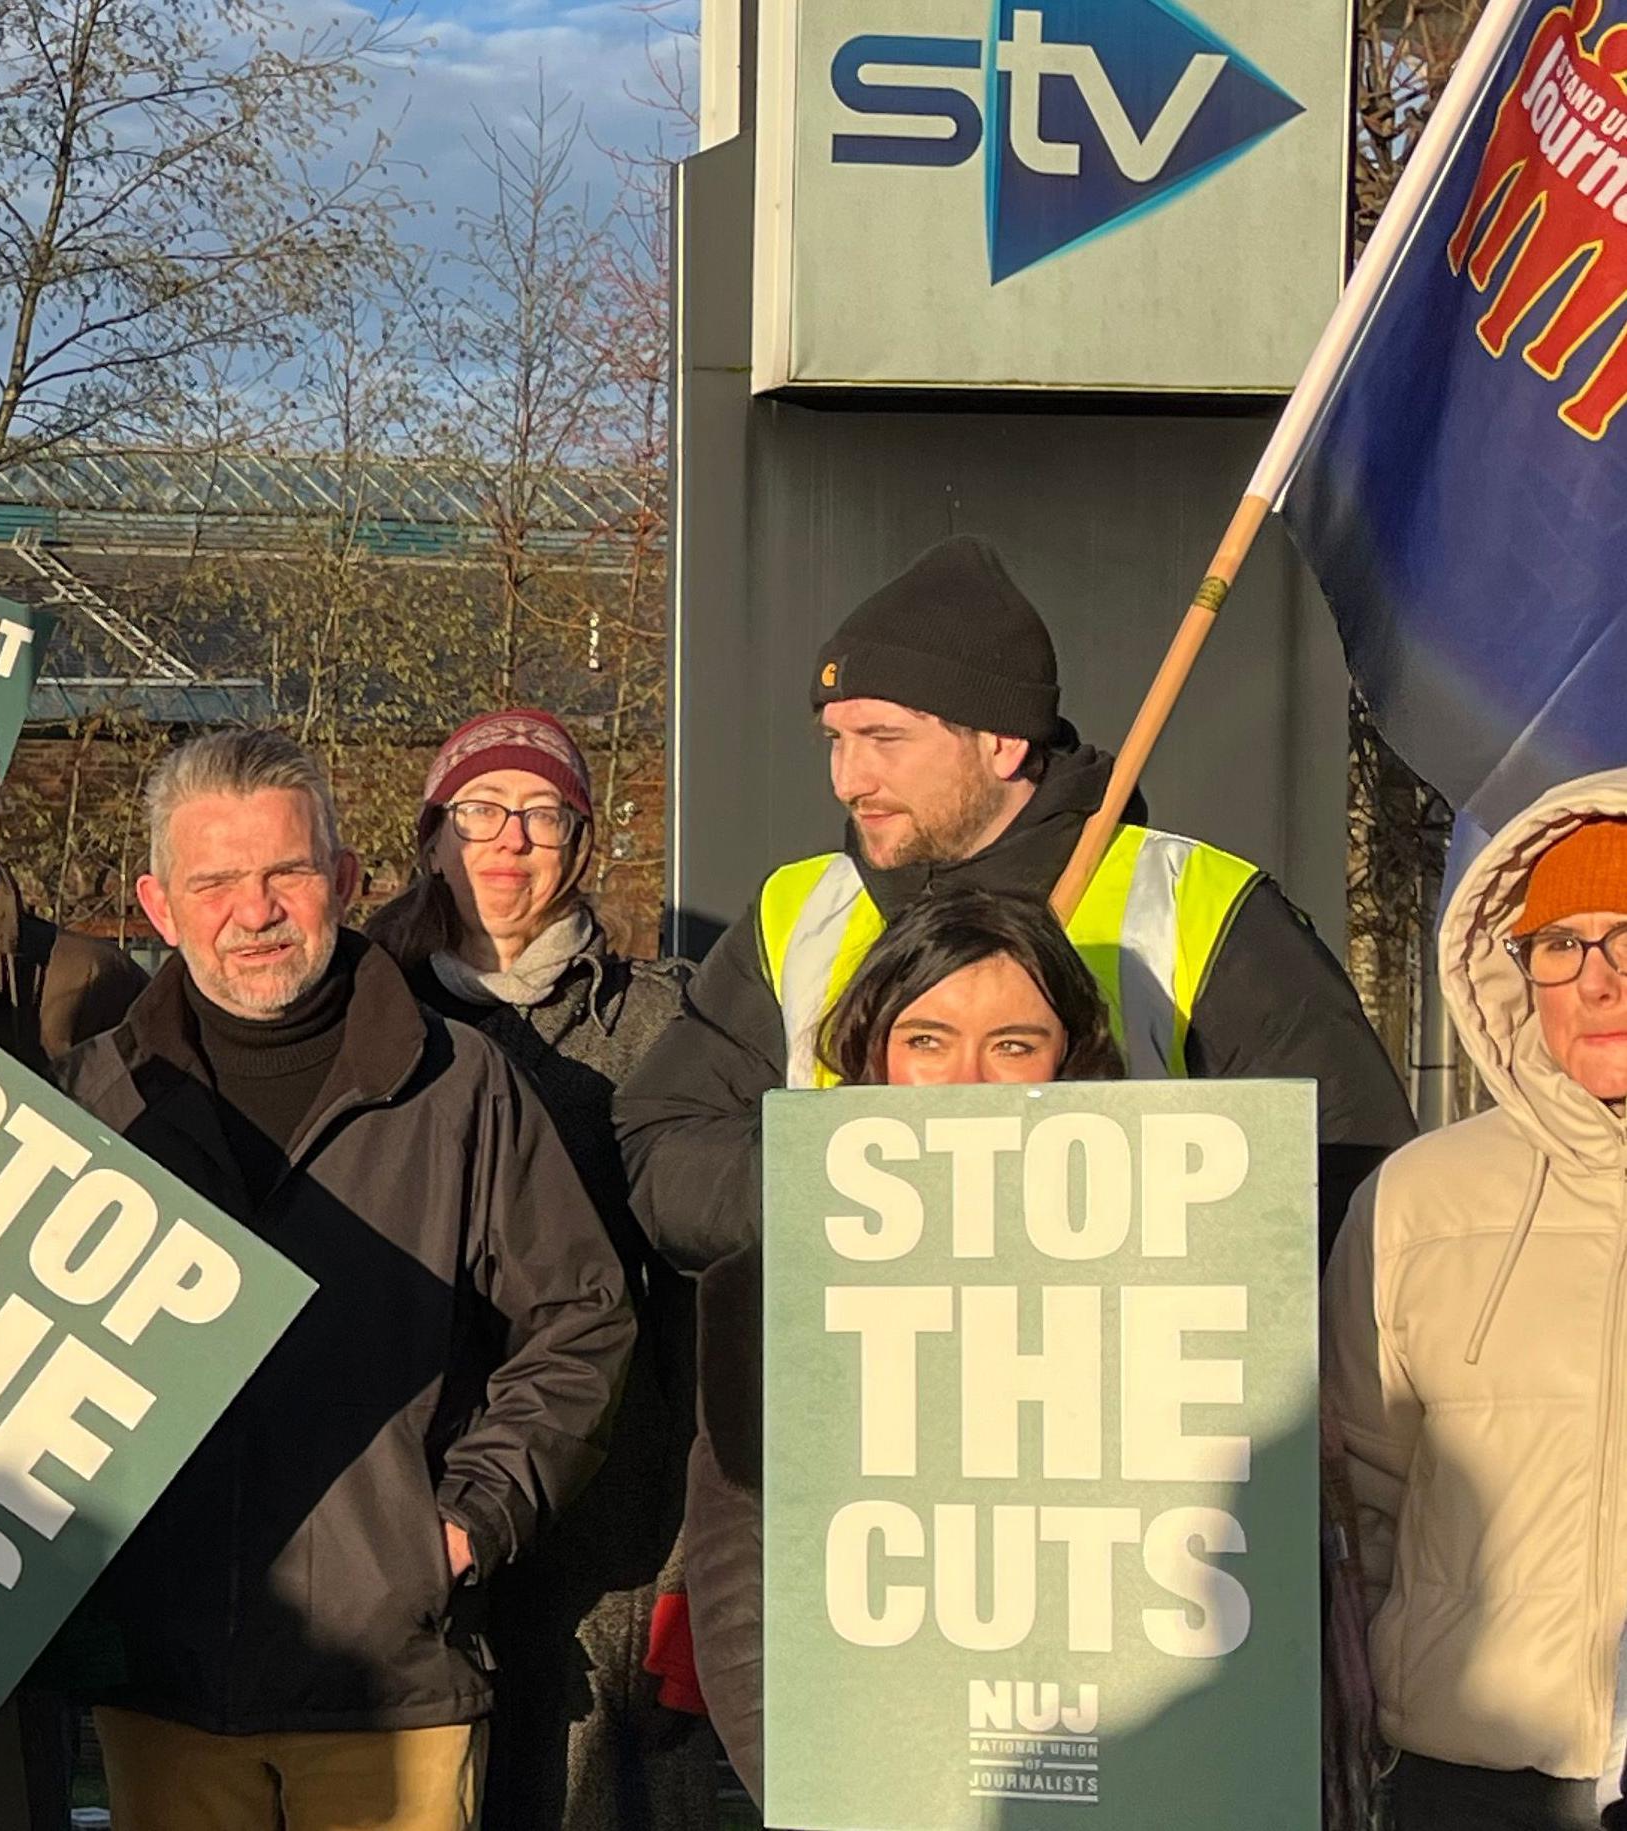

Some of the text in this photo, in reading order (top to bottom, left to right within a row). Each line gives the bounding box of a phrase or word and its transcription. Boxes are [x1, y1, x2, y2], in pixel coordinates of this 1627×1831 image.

[1556, 55, 1607, 121] STAND
[825, 1111, 1250, 1262] STOP
[825, 1285, 1251, 1482] THE
[825, 1499, 1252, 1658] CUTS
[969, 1680, 1099, 1734] NUJ
[970, 1740, 1098, 1758] NATIONAL UNION
[1025, 1759, 1041, 1771] OF
[969, 1771, 1099, 1793] JOURNALISTS
